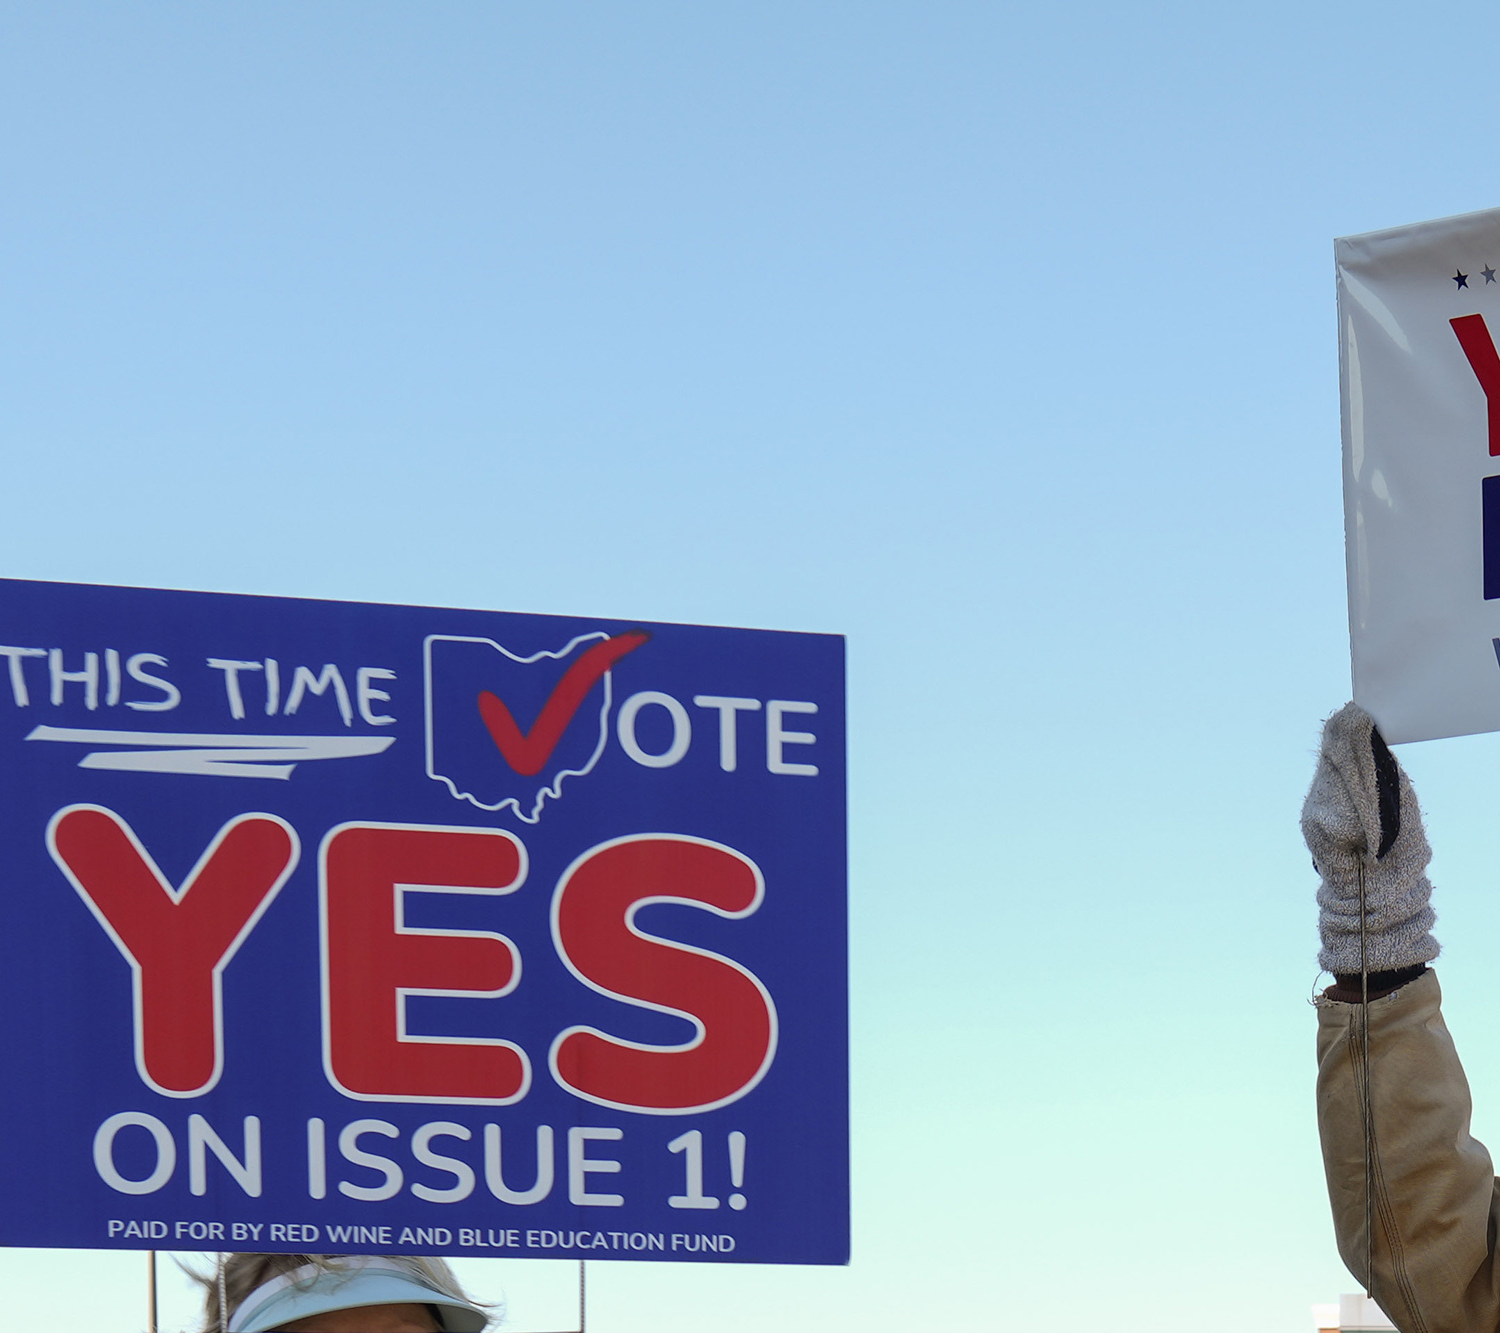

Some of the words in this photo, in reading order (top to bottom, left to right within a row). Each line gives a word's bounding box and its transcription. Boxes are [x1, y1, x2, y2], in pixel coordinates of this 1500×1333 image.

[206, 656, 397, 728] TIME
[45, 803, 779, 1117] YES
[92, 1110, 263, 1198] ON
[308, 1115, 625, 1208] ISSUE
[667, 1130, 747, 1212] 1!
[107, 1219, 168, 1239] PAID
[174, 1221, 225, 1240] FOR
[231, 1222, 263, 1242] BY
[270, 1223, 320, 1243] RED
[326, 1224, 392, 1245] WINE
[398, 1226, 452, 1246] AND
[458, 1228, 520, 1248] BLUE
[526, 1229, 665, 1251] EDUCATION
[671, 1233, 736, 1253] FUND
